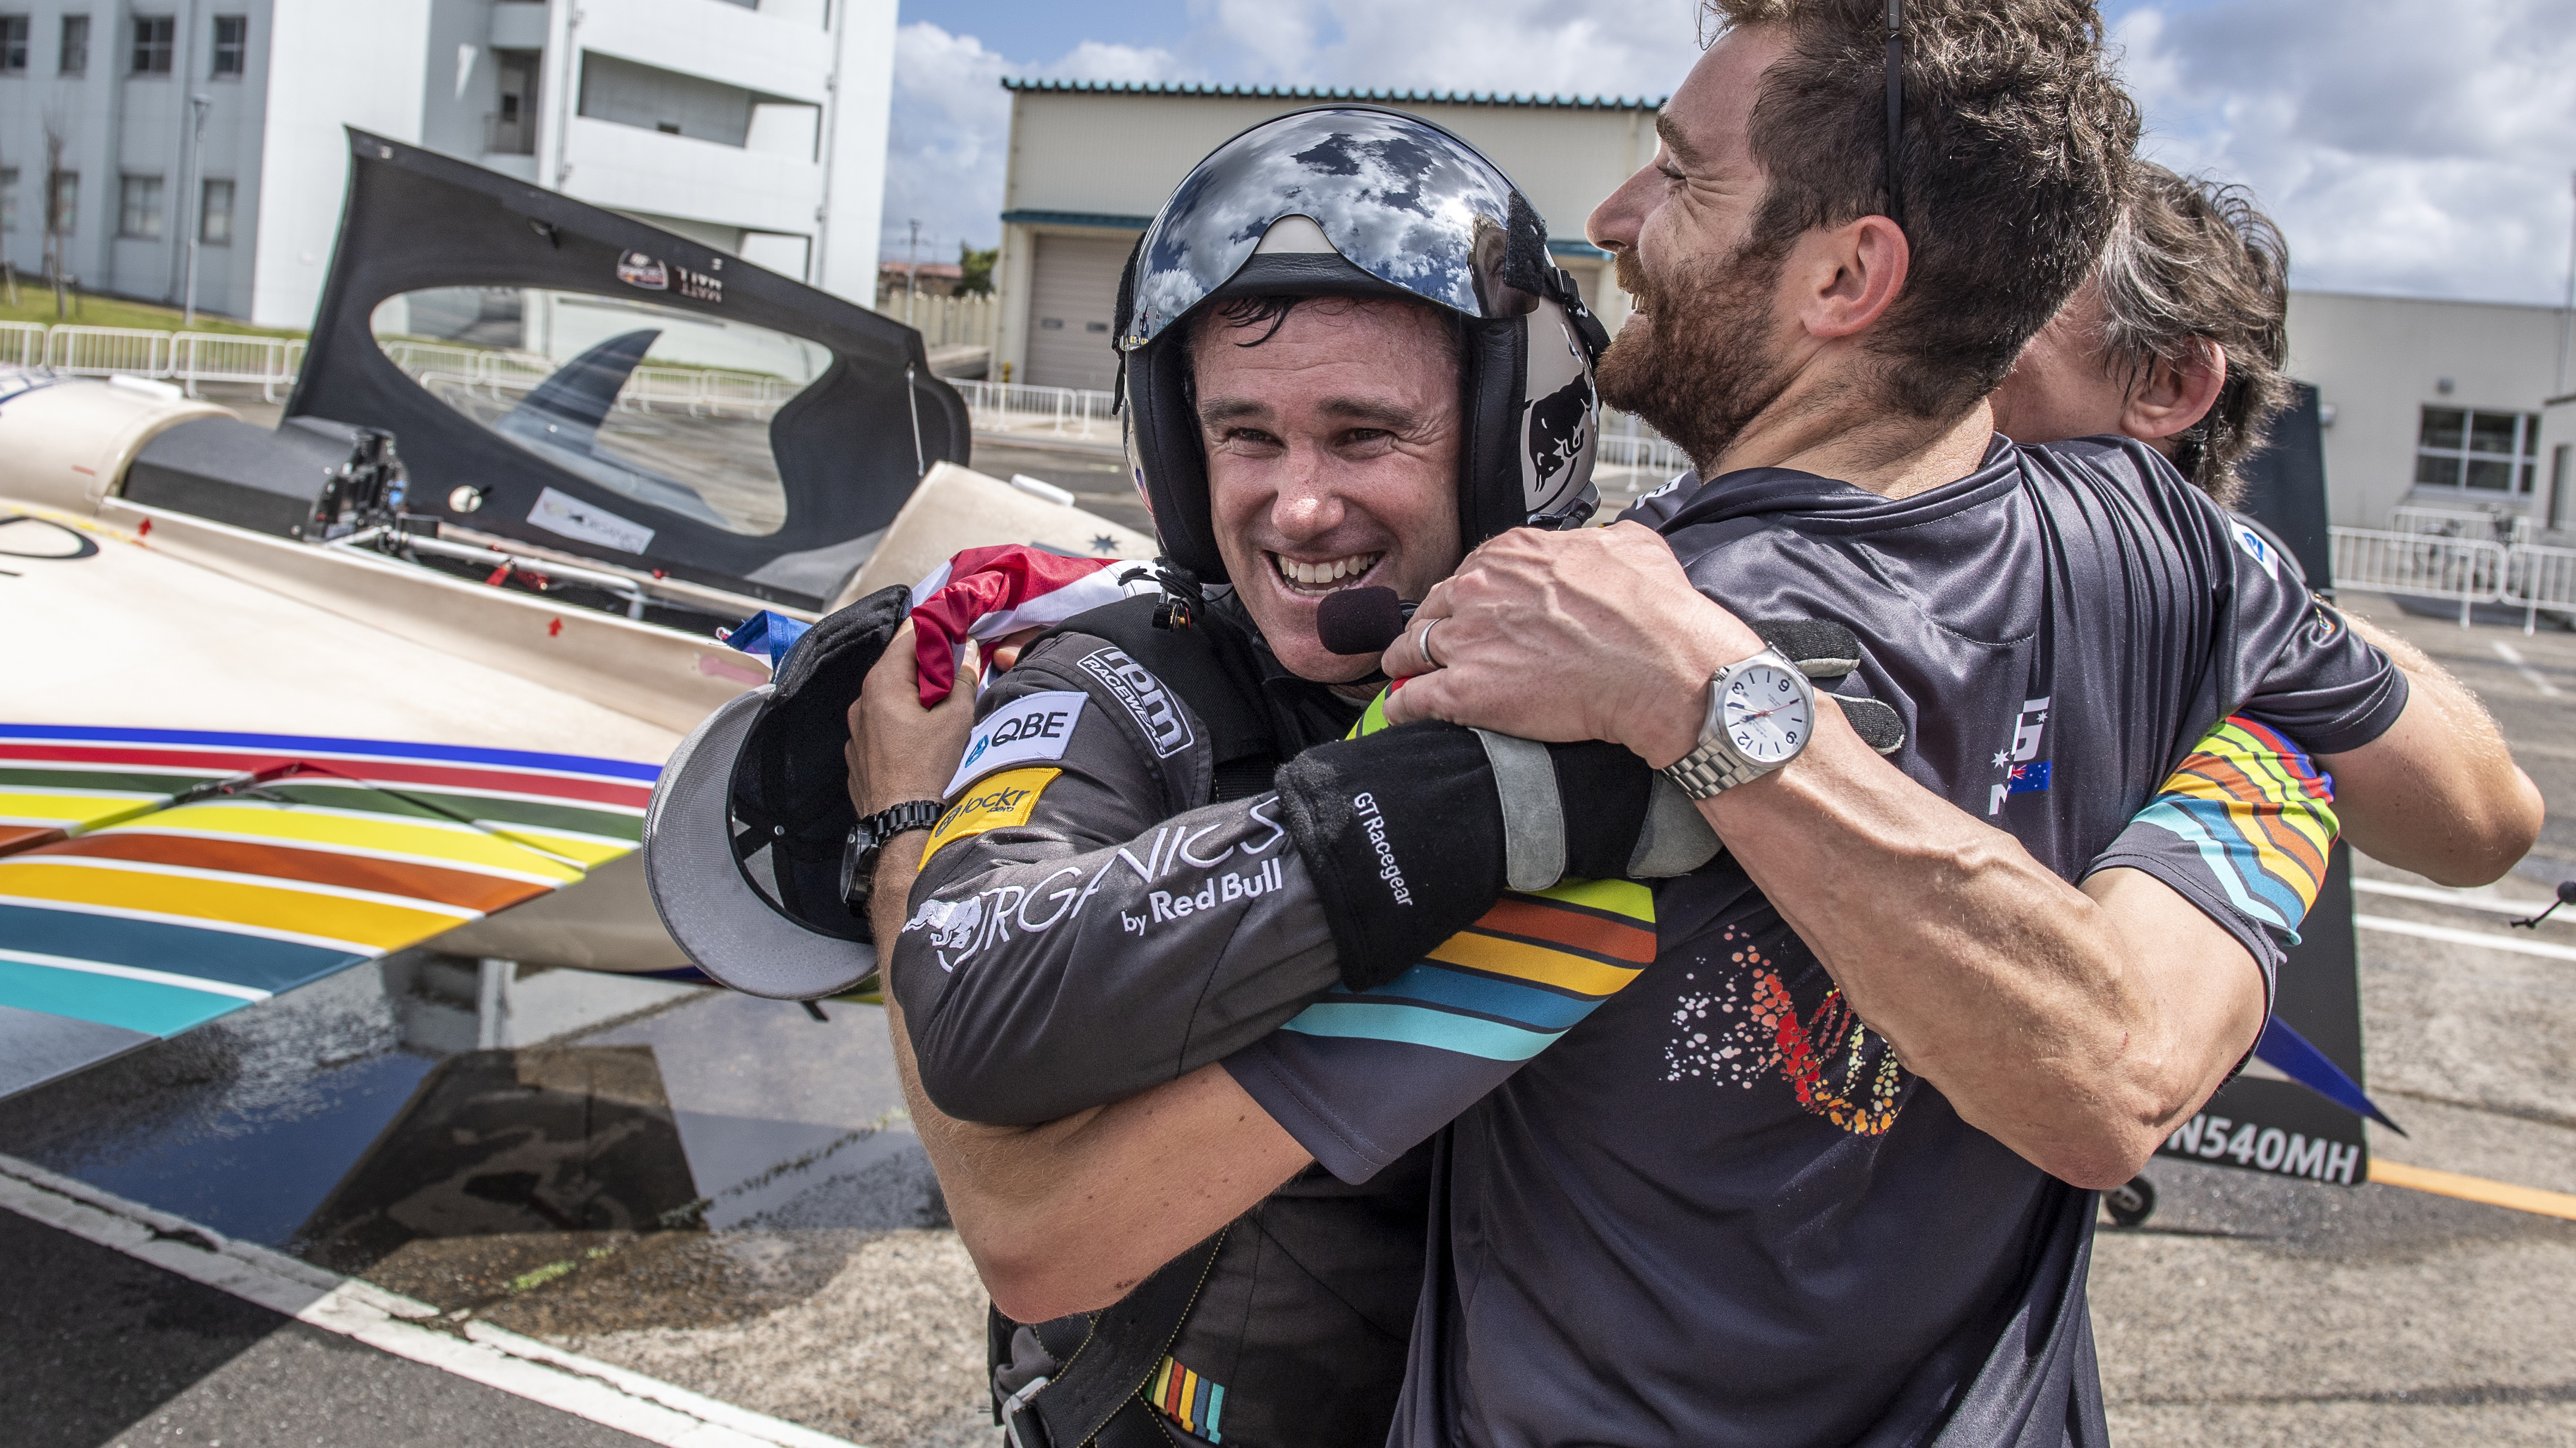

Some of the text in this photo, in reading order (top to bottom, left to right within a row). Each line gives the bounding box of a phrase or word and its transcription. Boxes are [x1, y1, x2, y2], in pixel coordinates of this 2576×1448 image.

[1084, 660, 1166, 753] RACEWEAR
[1104, 651, 1182, 747] rpm
[1732, 681, 1744, 695] 3
[1778, 679, 1790, 692] 6
[992, 712, 1068, 747] QBE
[1737, 731, 1753, 750] 12
[1121, 858, 1283, 936] by Red Bull
[2166, 1113, 2360, 1185] N540MH
